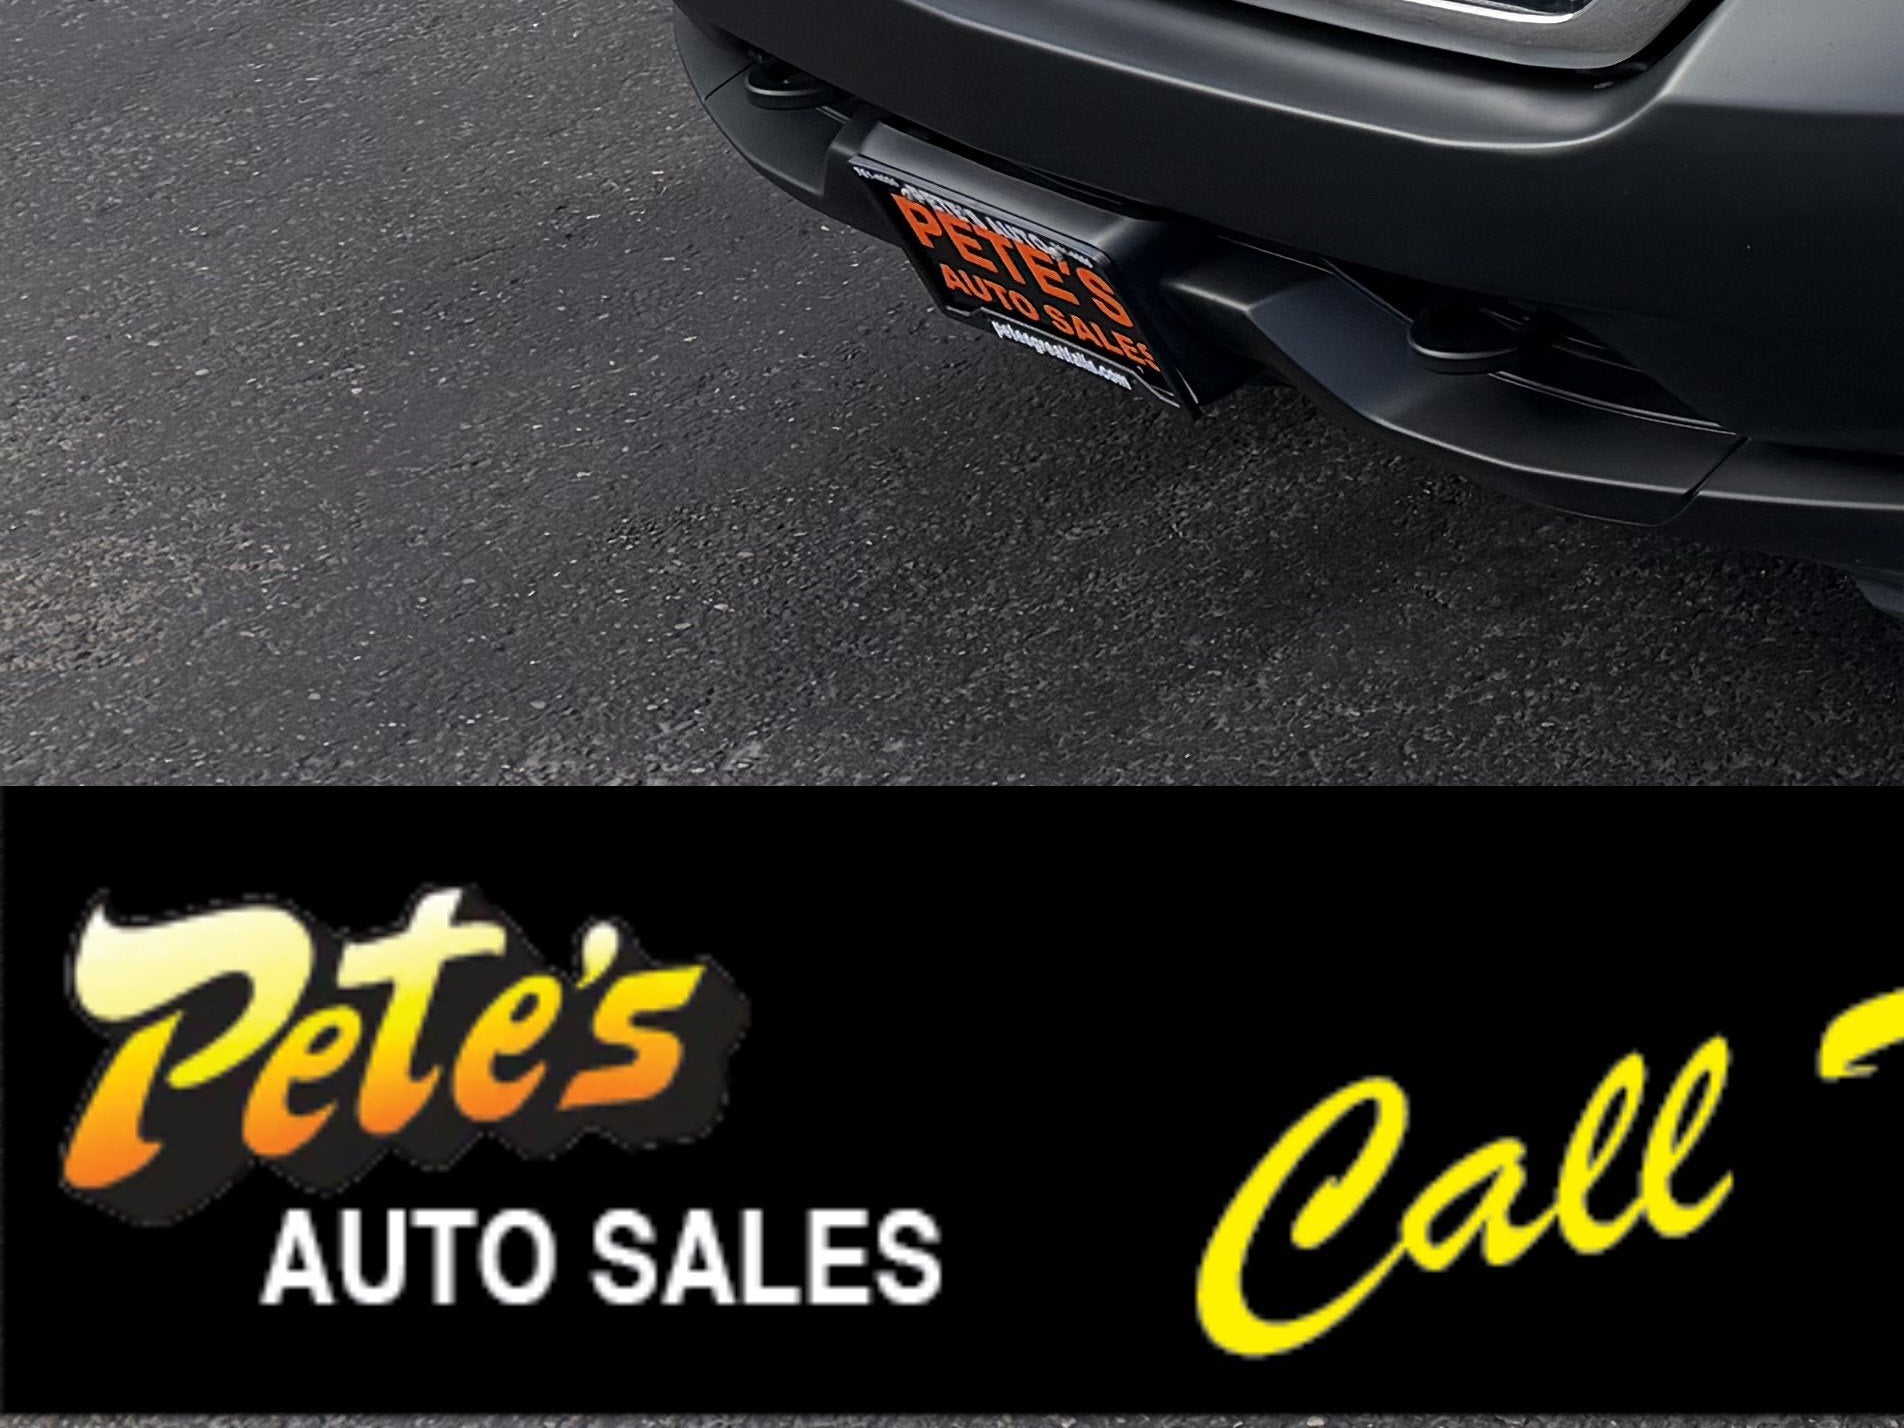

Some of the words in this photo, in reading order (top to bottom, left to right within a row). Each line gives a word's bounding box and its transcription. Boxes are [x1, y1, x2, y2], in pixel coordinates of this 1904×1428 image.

[891, 193, 1134, 327] PETE'S
[940, 263, 1040, 322] AUTO
[1044, 304, 1162, 372] SALES
